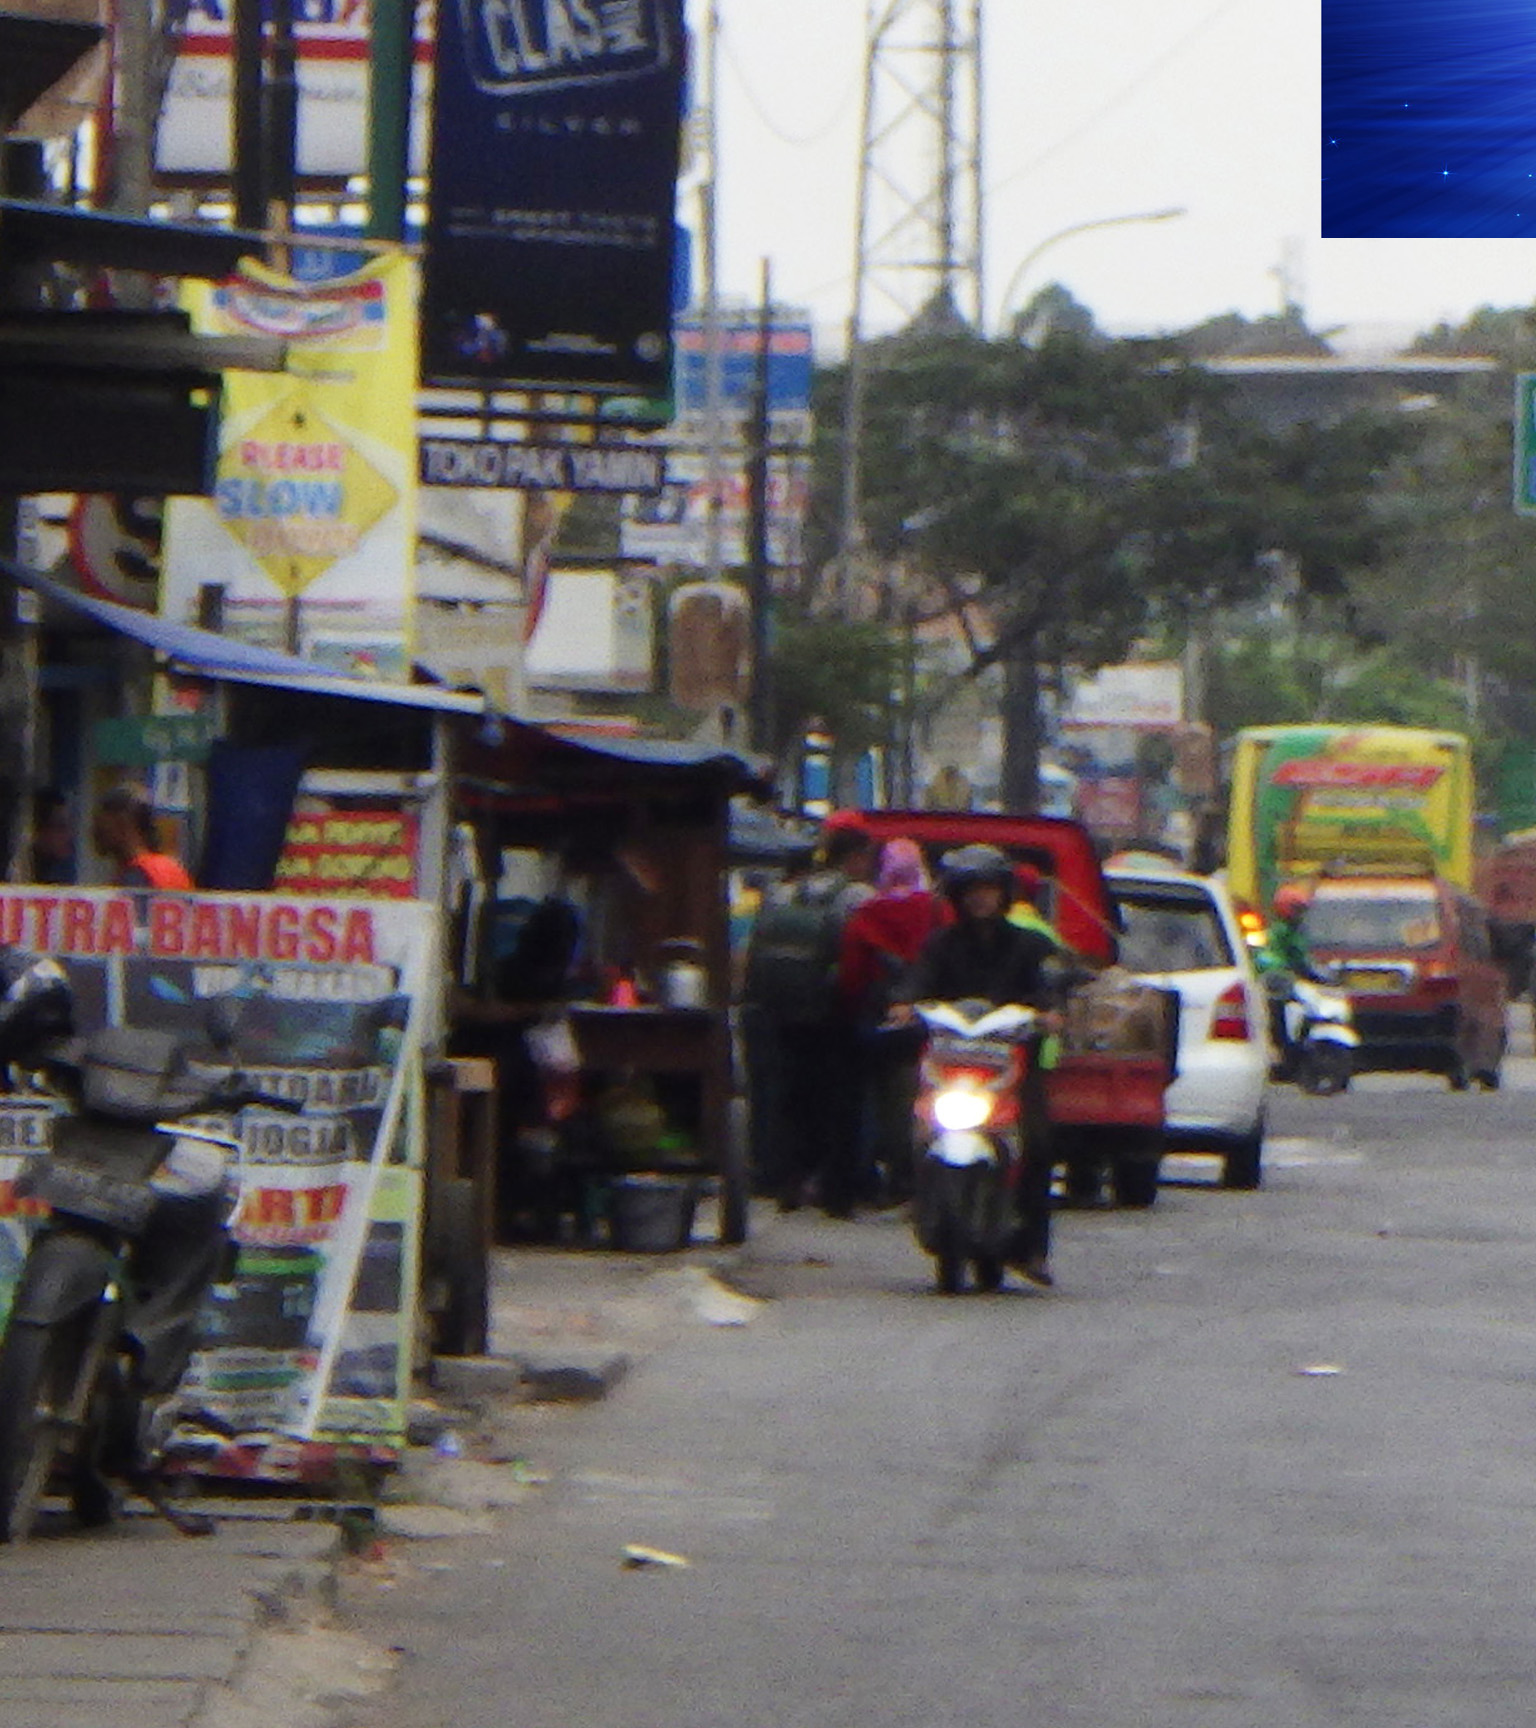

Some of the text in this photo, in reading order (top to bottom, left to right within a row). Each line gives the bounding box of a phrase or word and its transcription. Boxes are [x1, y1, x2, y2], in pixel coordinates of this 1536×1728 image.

[240, 440, 345, 472] PLEASE
[215, 478, 343, 519] SLOW
[153, 901, 374, 962] BANGSA
